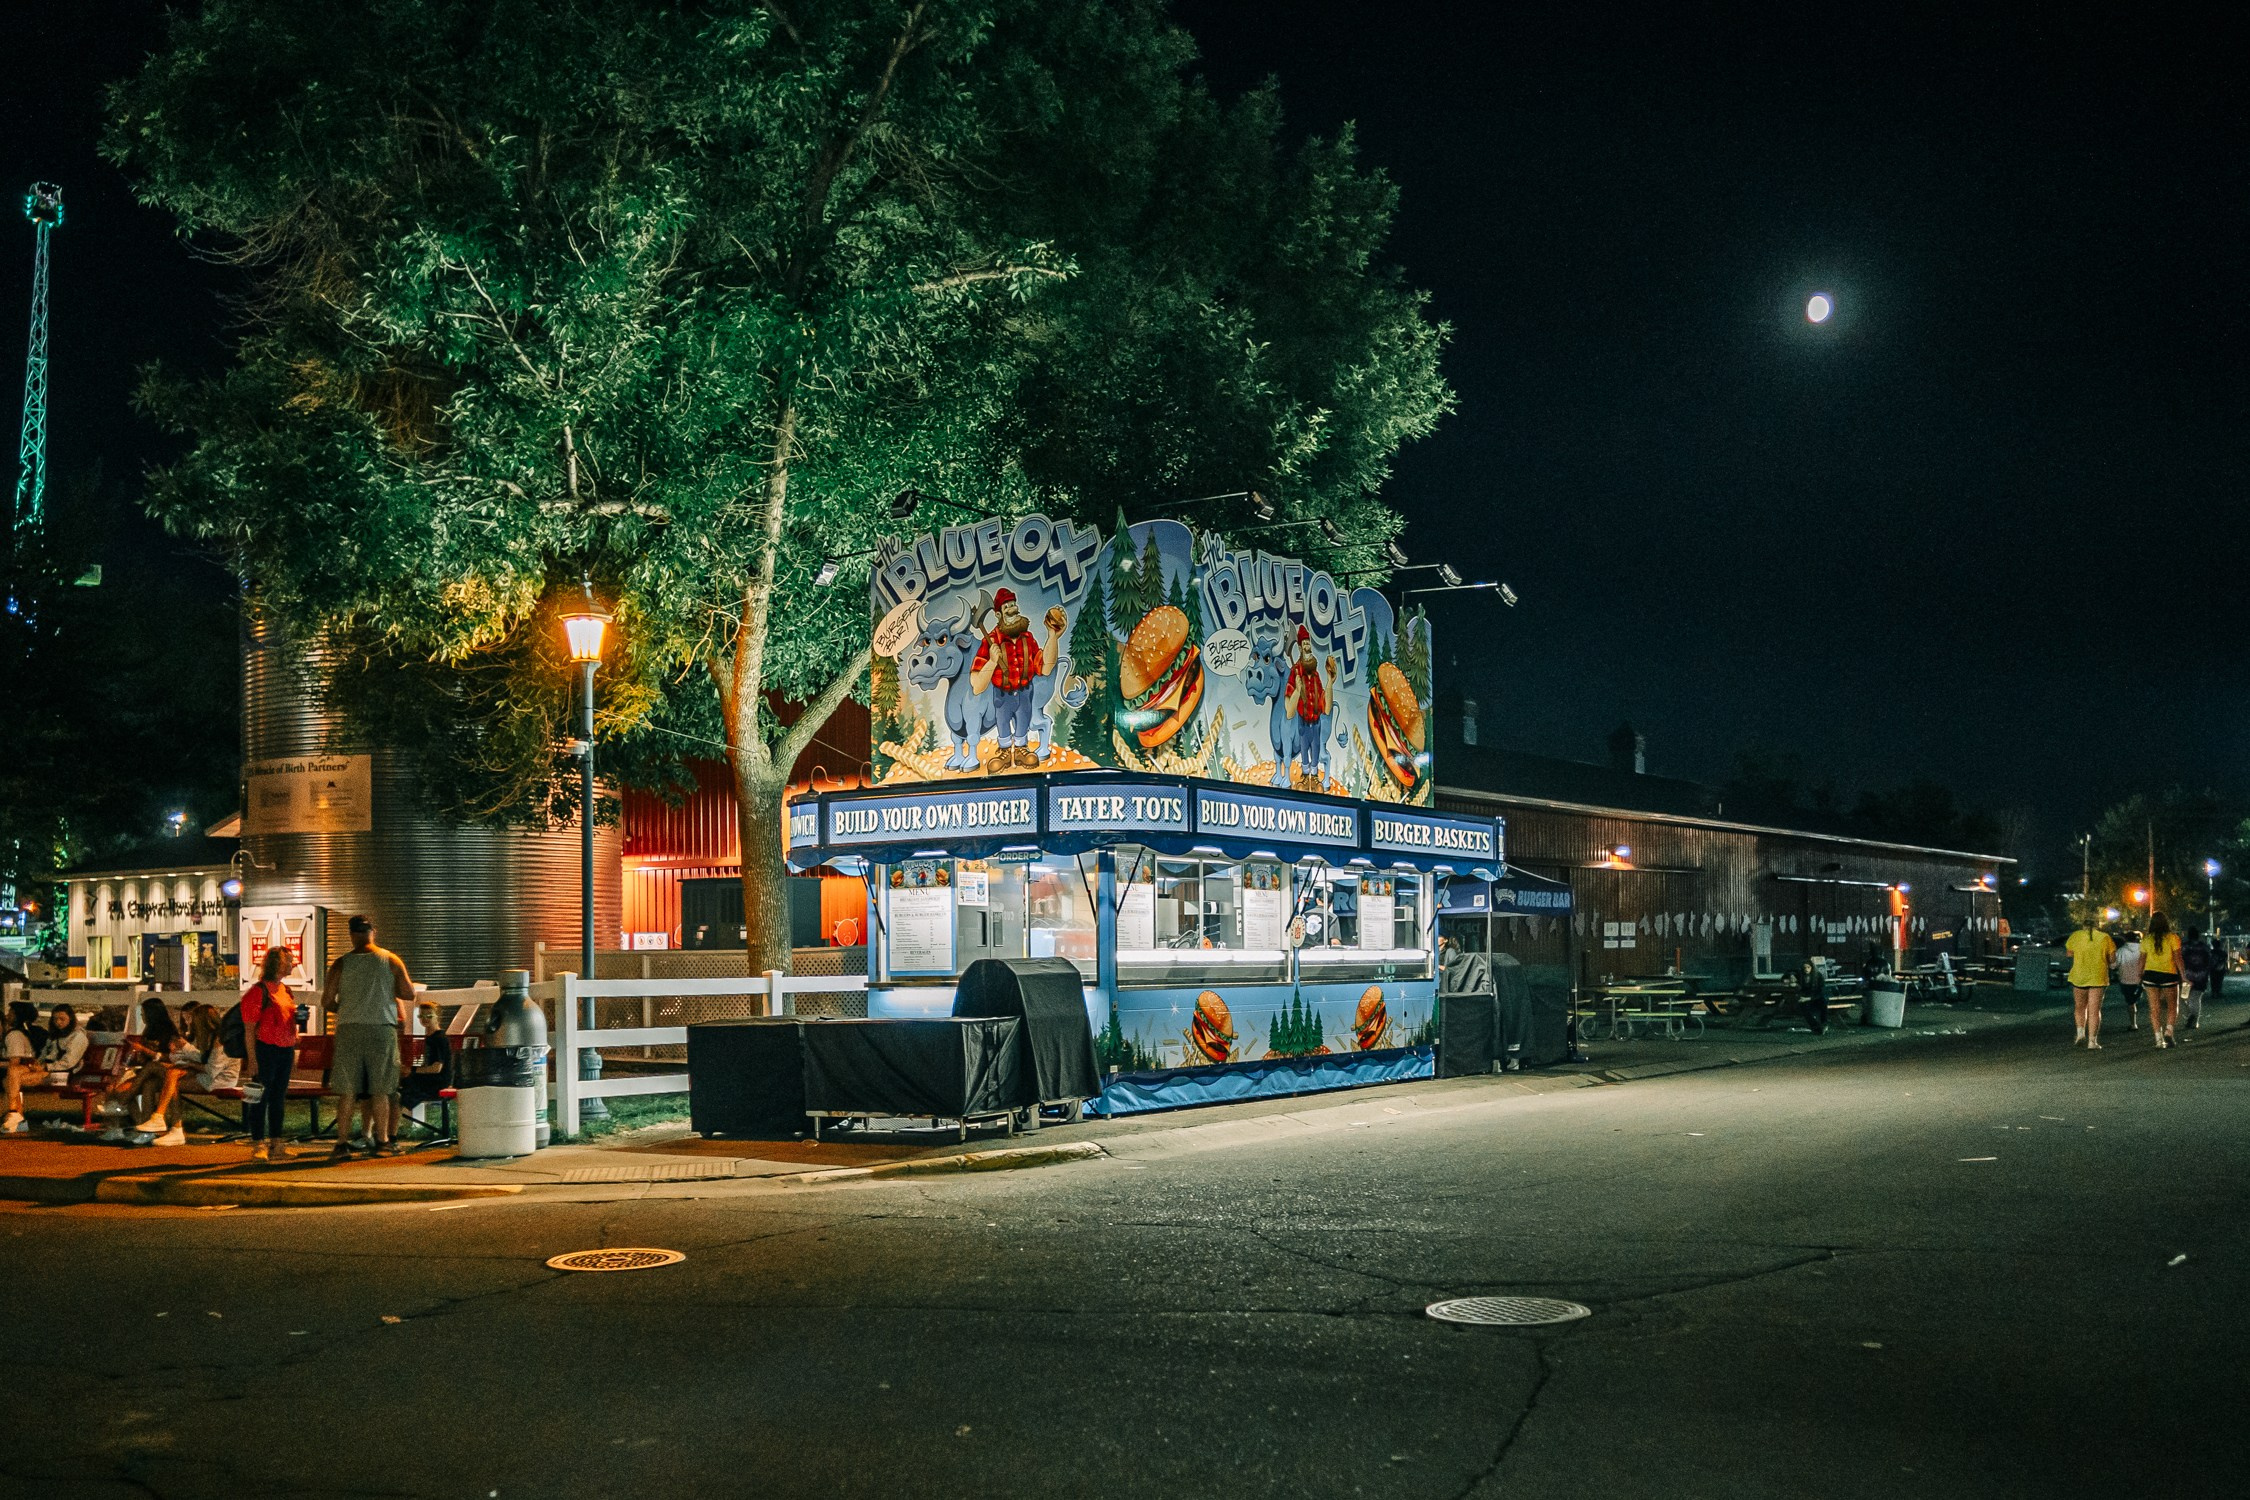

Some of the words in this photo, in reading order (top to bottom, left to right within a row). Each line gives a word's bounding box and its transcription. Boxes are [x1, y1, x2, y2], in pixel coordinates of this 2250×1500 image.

[876, 534, 900, 571] the
[882, 519, 1003, 601] BLUE
[1011, 516, 1099, 594] OX
[1202, 532, 1224, 581] the
[876, 602, 919, 646] BURGER
[1208, 555, 1305, 629] BLUE
[1309, 573, 1366, 668] OX
[882, 621, 910, 653] BAR!
[1206, 640, 1249, 657] BURGER
[1211, 651, 1237, 669] BAR!
[285, 762, 306, 773] Birth
[835, 808, 879, 834] BUILD
[882, 806, 923, 831] YOUR
[926, 803, 964, 828] OWN
[967, 799, 1031, 826] BURGER
[1058, 796, 1125, 821] TATER
[1131, 796, 1182, 821] TOTS
[1201, 799, 1240, 826] BUILD
[1242, 804, 1276, 831] YOUR
[1278, 808, 1307, 833] OWN
[1309, 812, 1353, 839] BURGER
[1374, 819, 1432, 847] BURGER
[1434, 826, 1490, 852] BASKETS
[999, 852, 1030, 862] ORDER
[909, 888, 930, 896] MENU
[1517, 890, 1552, 907] BURGER
[1552, 892, 1571, 908] BAR
